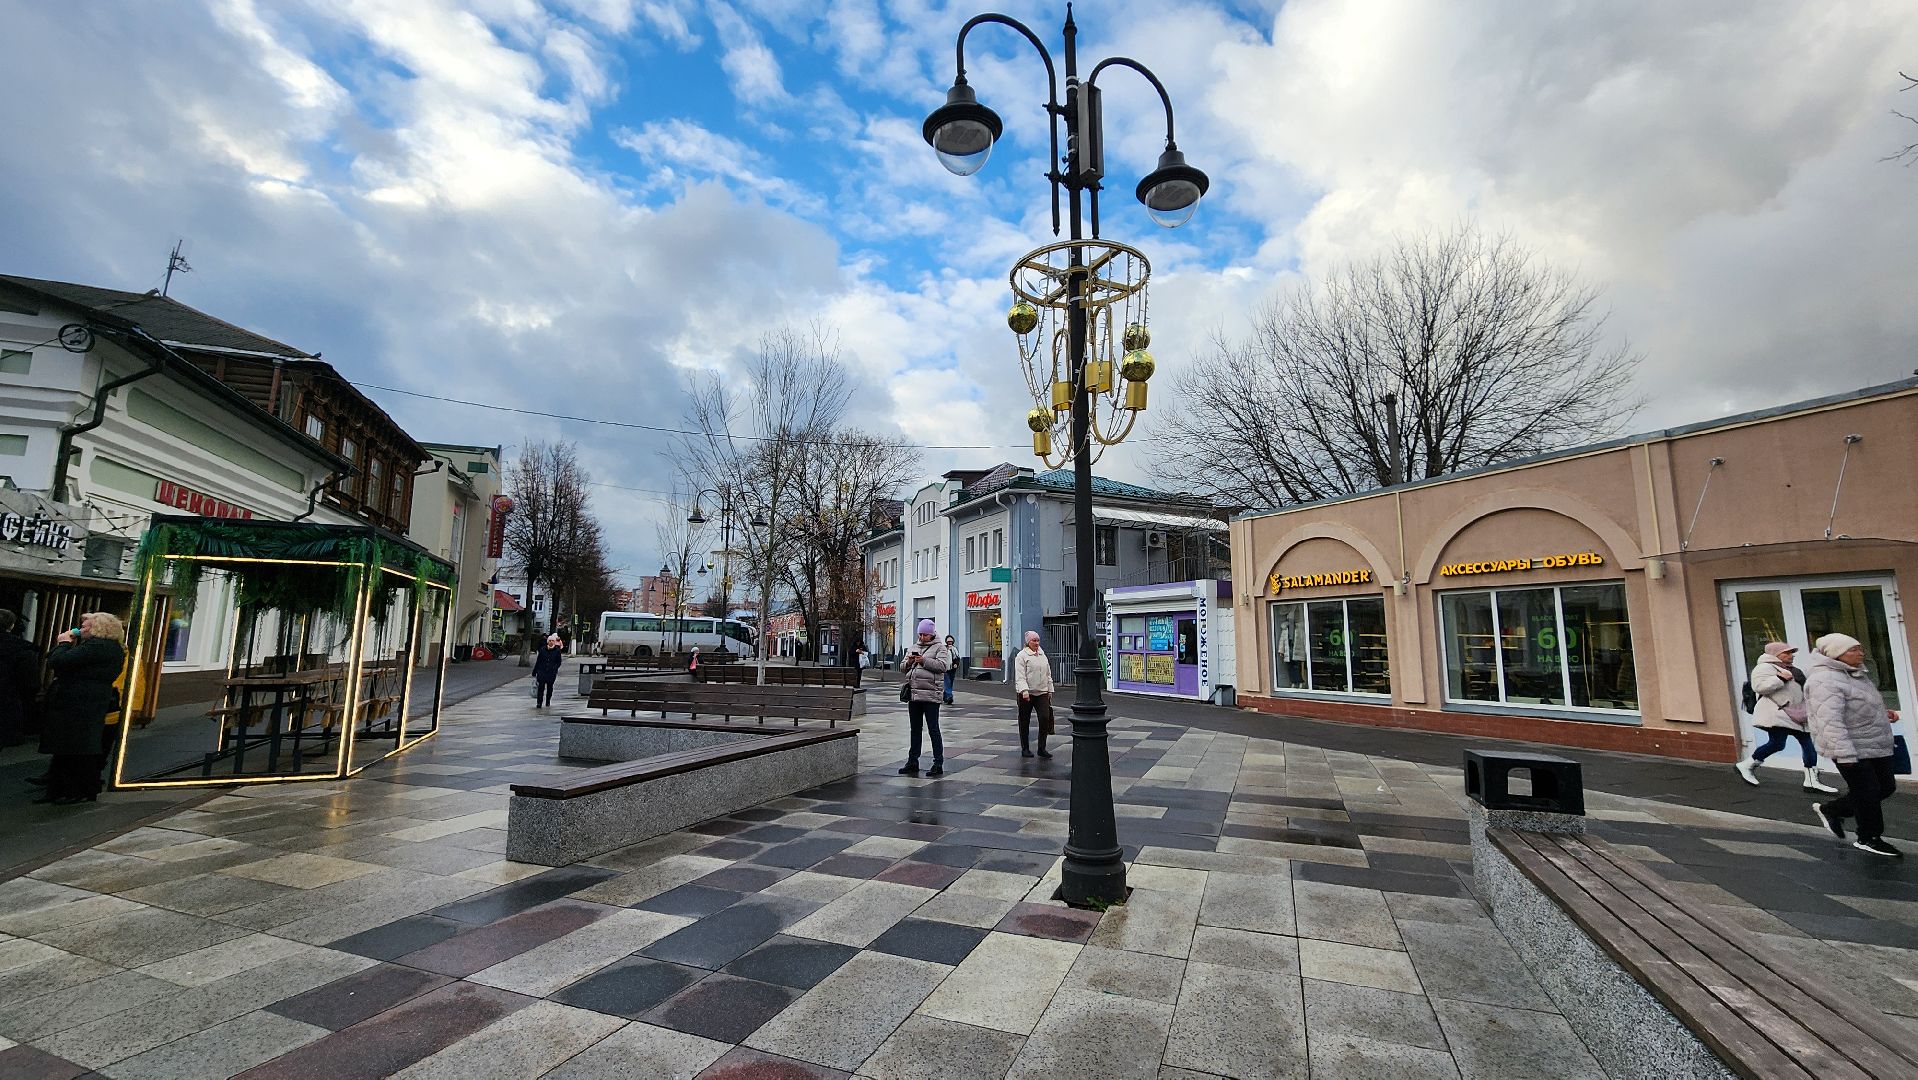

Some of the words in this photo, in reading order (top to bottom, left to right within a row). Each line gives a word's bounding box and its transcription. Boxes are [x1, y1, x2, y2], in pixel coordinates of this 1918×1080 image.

[1440, 558, 1531, 576] АКСЕССУАРЫ
[1543, 552, 1603, 568] ОБУВЬ
[1283, 569, 1370, 589] SALAMANDER
